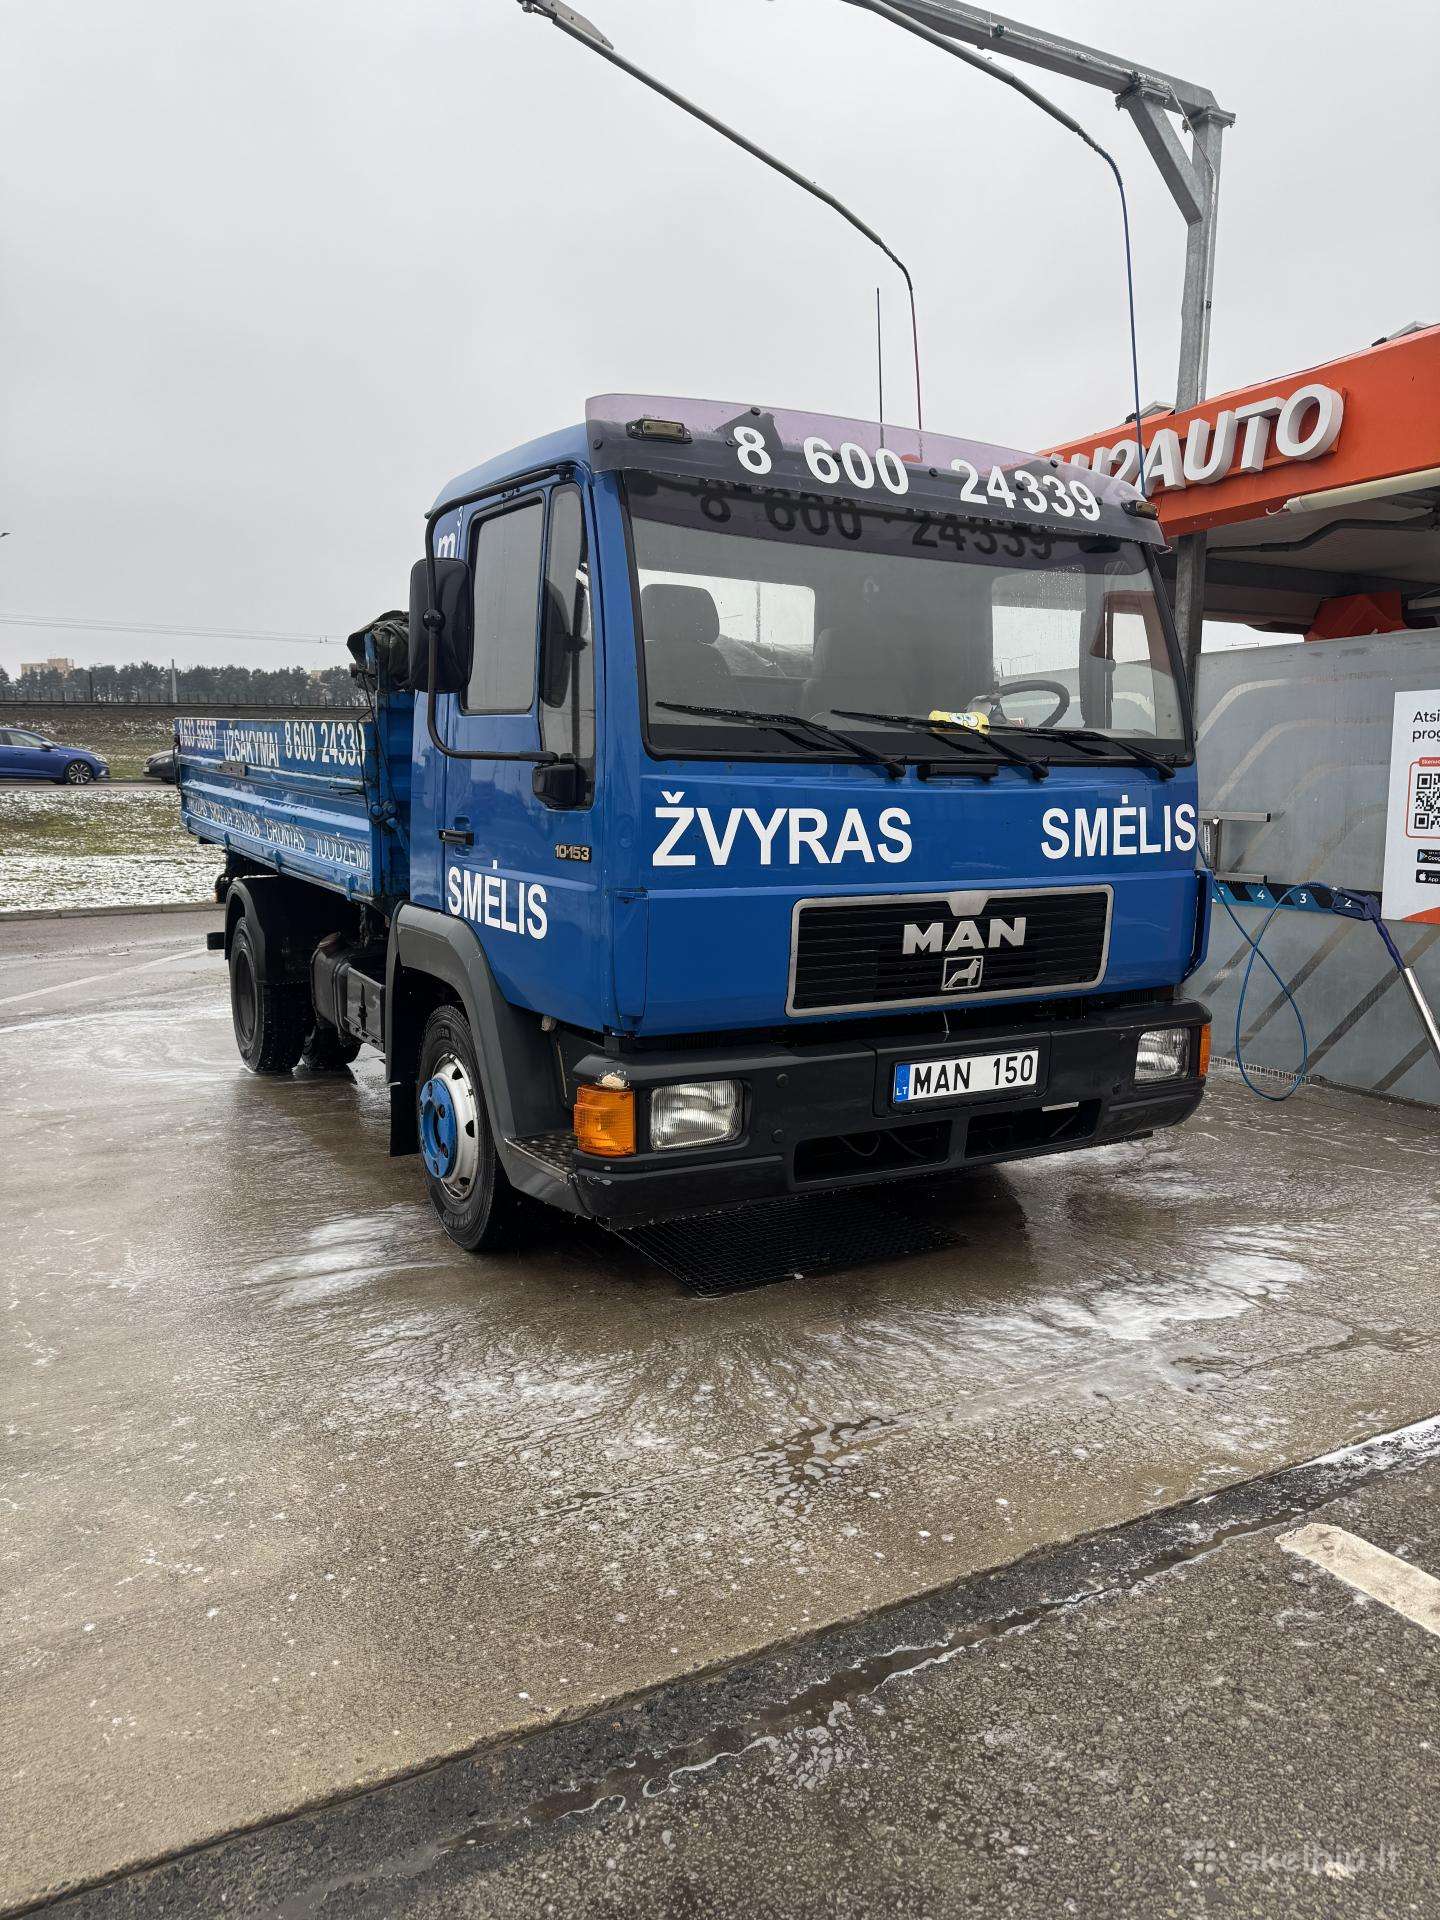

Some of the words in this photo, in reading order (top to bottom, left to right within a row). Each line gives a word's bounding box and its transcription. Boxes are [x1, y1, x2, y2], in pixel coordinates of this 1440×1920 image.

[1050, 384, 1344, 500] 2AUTO
[733, 426, 772, 475] 8
[803, 436, 909, 495] 600
[951, 459, 1100, 521] 24339
[223, 723, 279, 767] UŽSAKYMAI
[285, 721, 292, 758] 8
[294, 722, 316, 762] 600
[652, 790, 913, 867] ŽVYRAS
[1040, 794, 1197, 860] SMĖLIS
[447, 859, 548, 940] SMĖLIS
[1257, 889, 1265, 900] 4
[1299, 892, 1307, 904] 3
[902, 916, 1027, 955] MAN
[896, 1086, 908, 1096] LT
[913, 1061, 971, 1096] MAN
[993, 1054, 1034, 1086] 150
